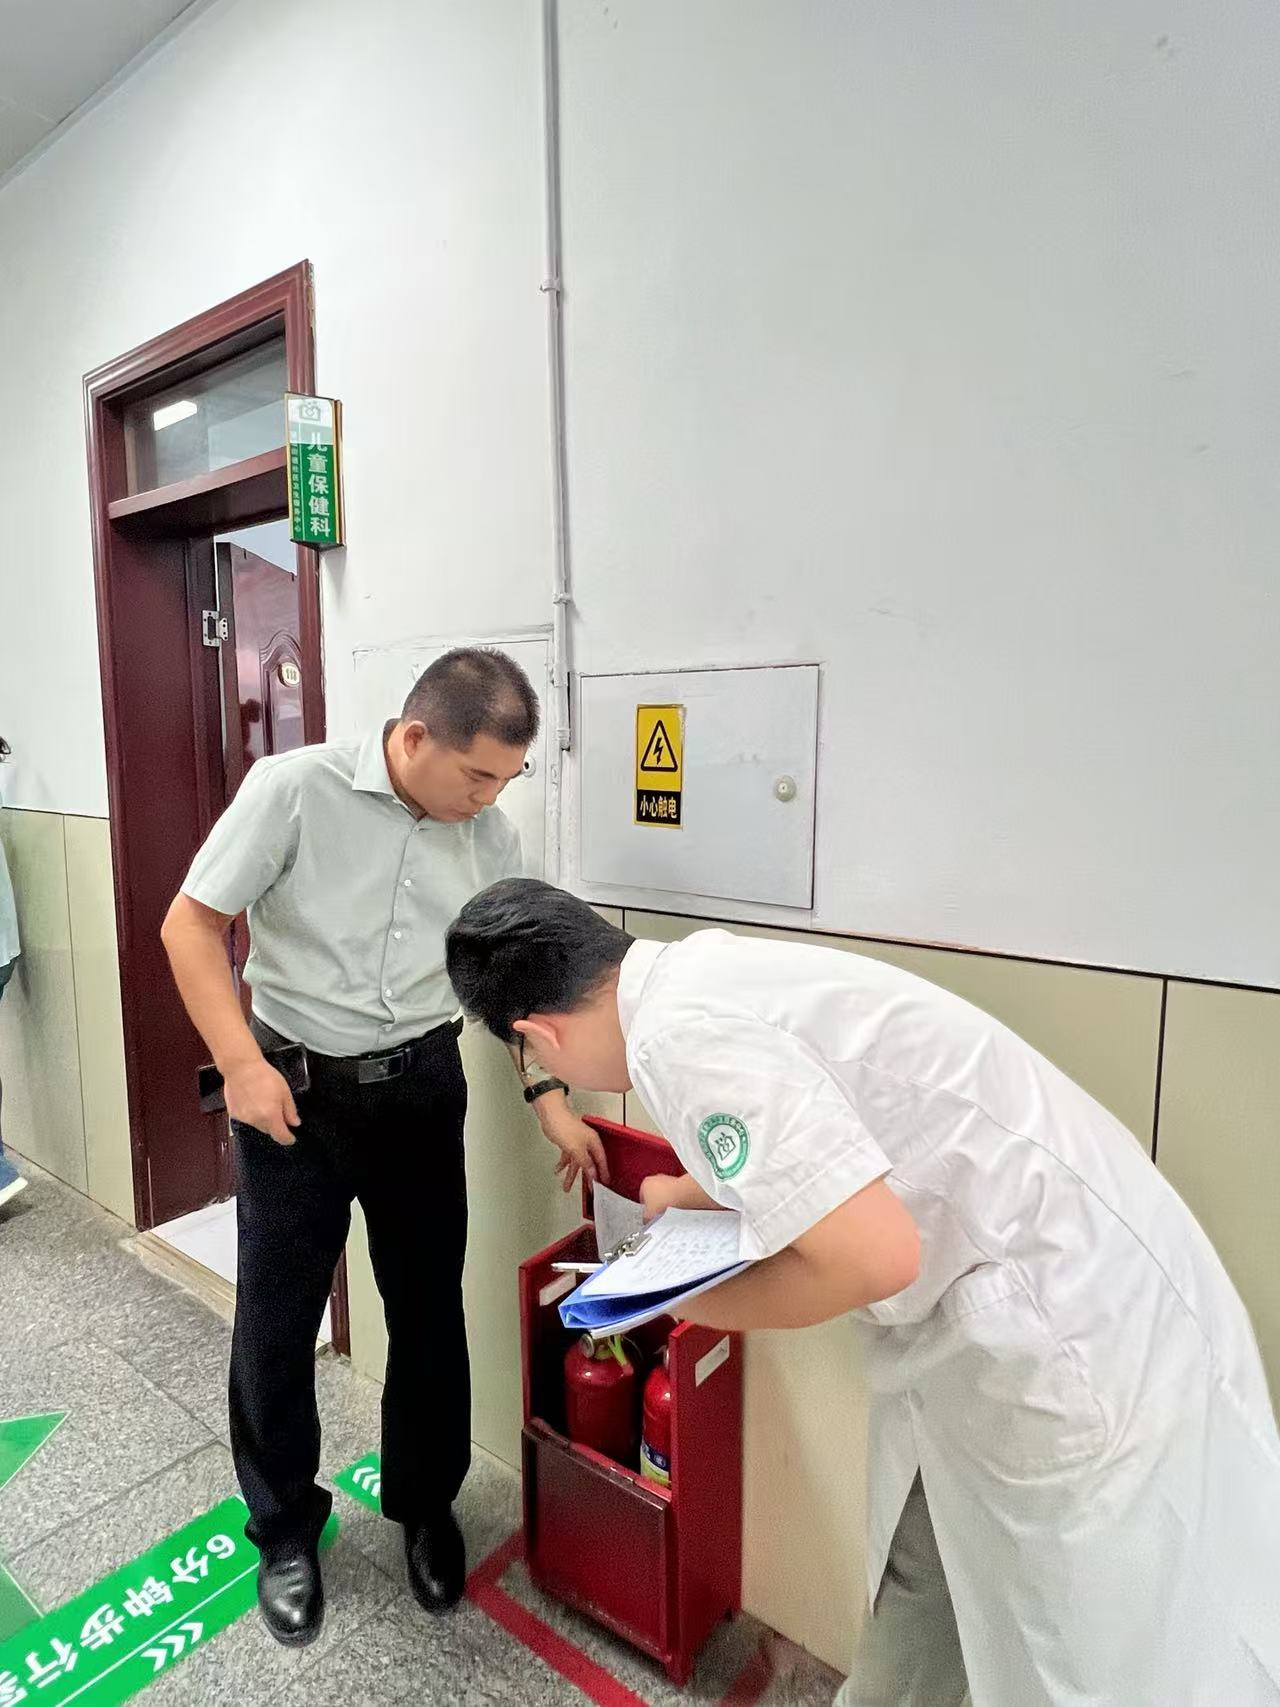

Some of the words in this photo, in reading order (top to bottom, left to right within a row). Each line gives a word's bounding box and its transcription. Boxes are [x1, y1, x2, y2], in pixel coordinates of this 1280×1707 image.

[306, 431, 331, 537] 儿童保健科
[640, 795, 678, 818] 小心触电
